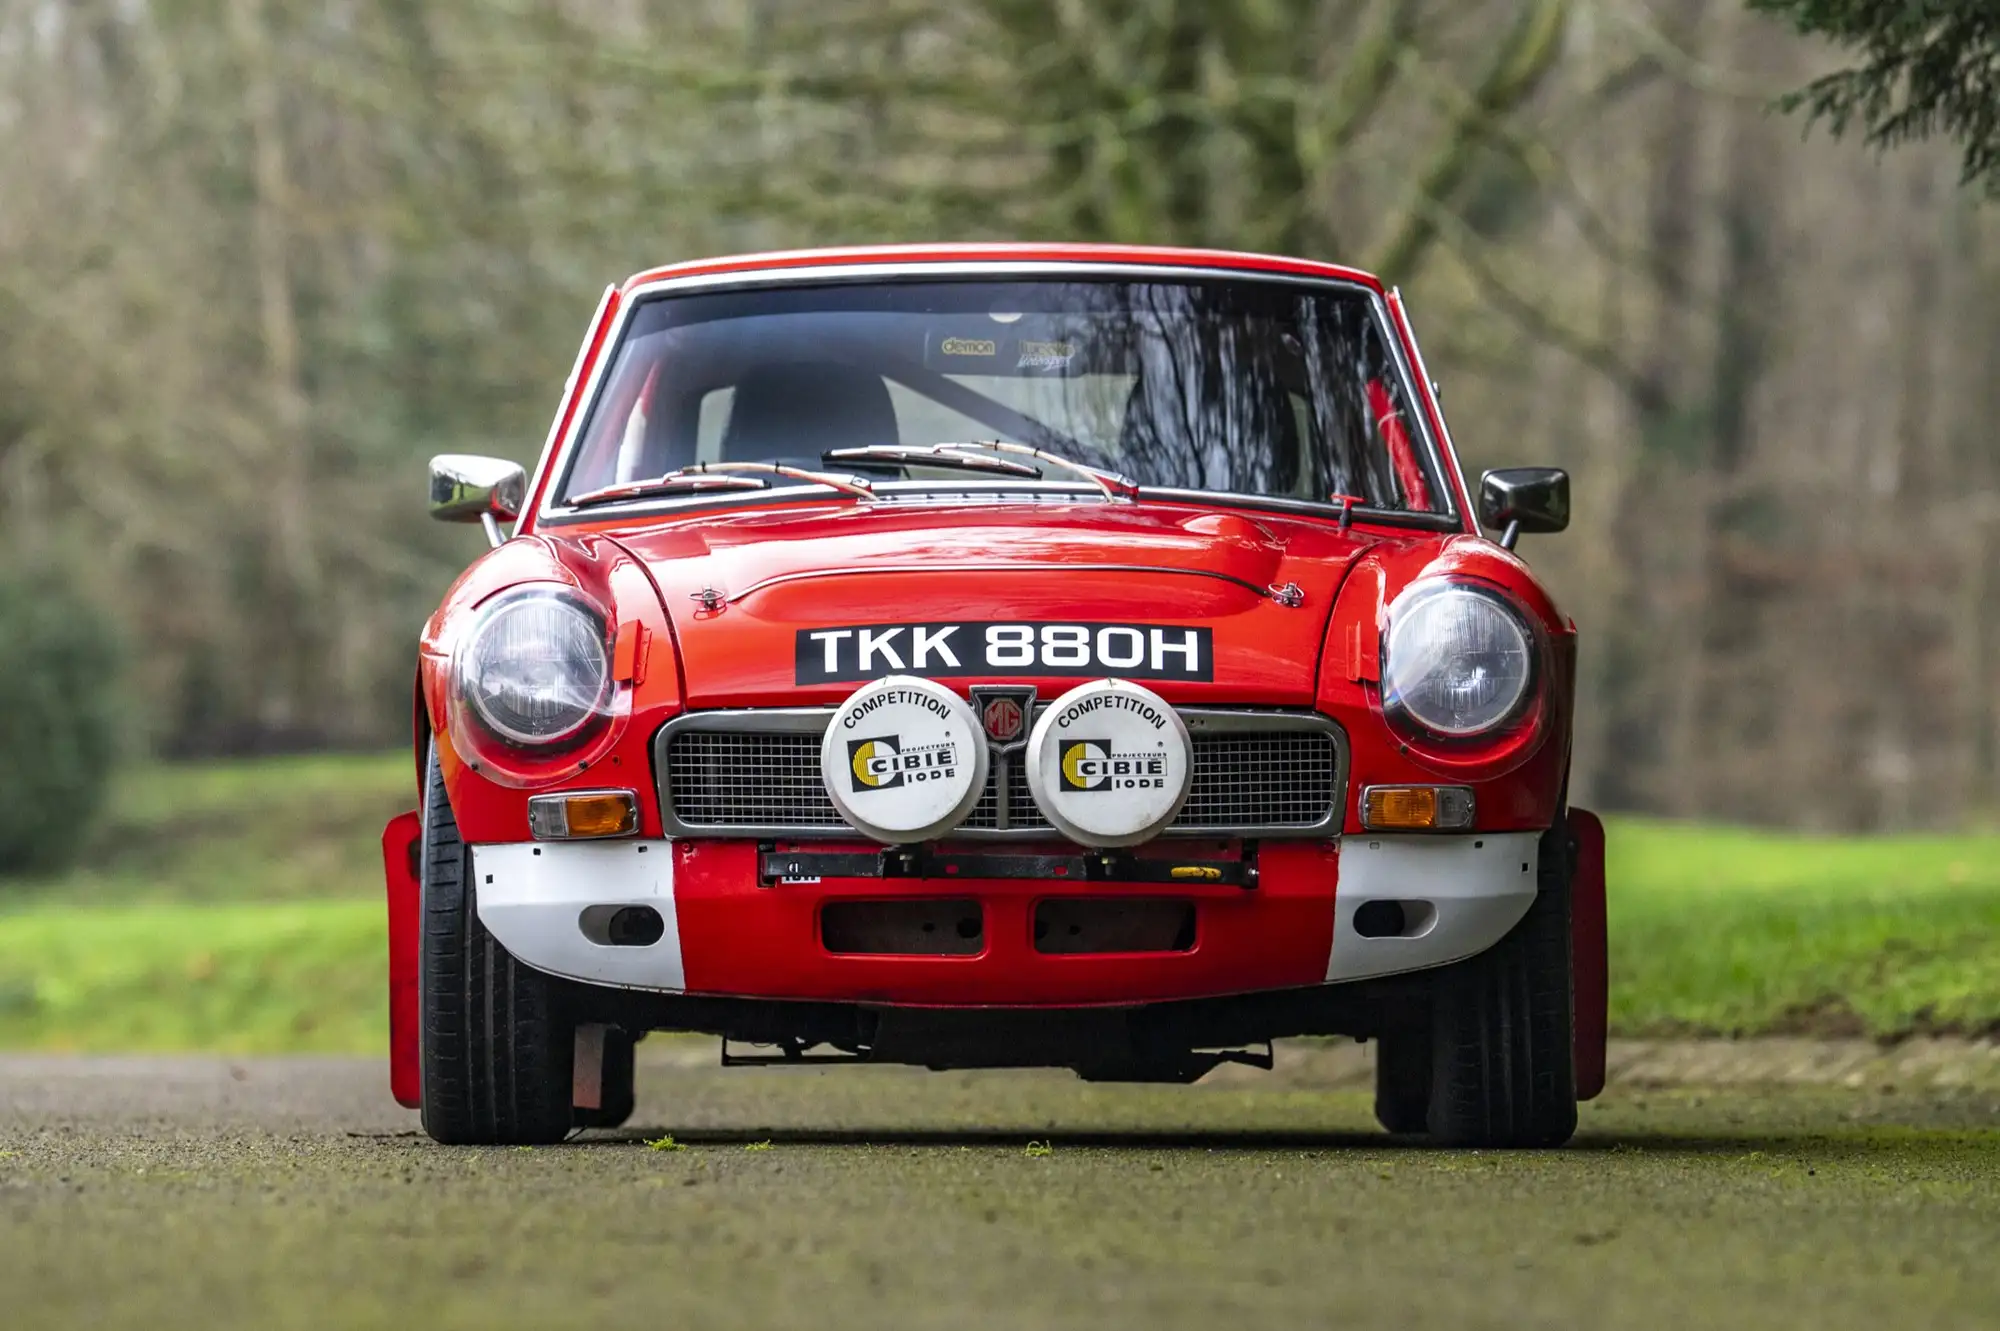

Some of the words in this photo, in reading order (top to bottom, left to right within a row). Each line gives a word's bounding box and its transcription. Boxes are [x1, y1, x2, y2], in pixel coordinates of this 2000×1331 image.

[942, 337, 995, 355] demon
[810, 626, 962, 673] TKK
[985, 625, 1199, 672] 880H
[844, 691, 951, 729] COMPETITION
[987, 700, 1020, 737] MG
[1058, 696, 1166, 730] COMPETITION
[901, 742, 955, 753] PROJECTEURS
[908, 768, 955, 783] IODE
[1115, 779, 1164, 789] IODE
